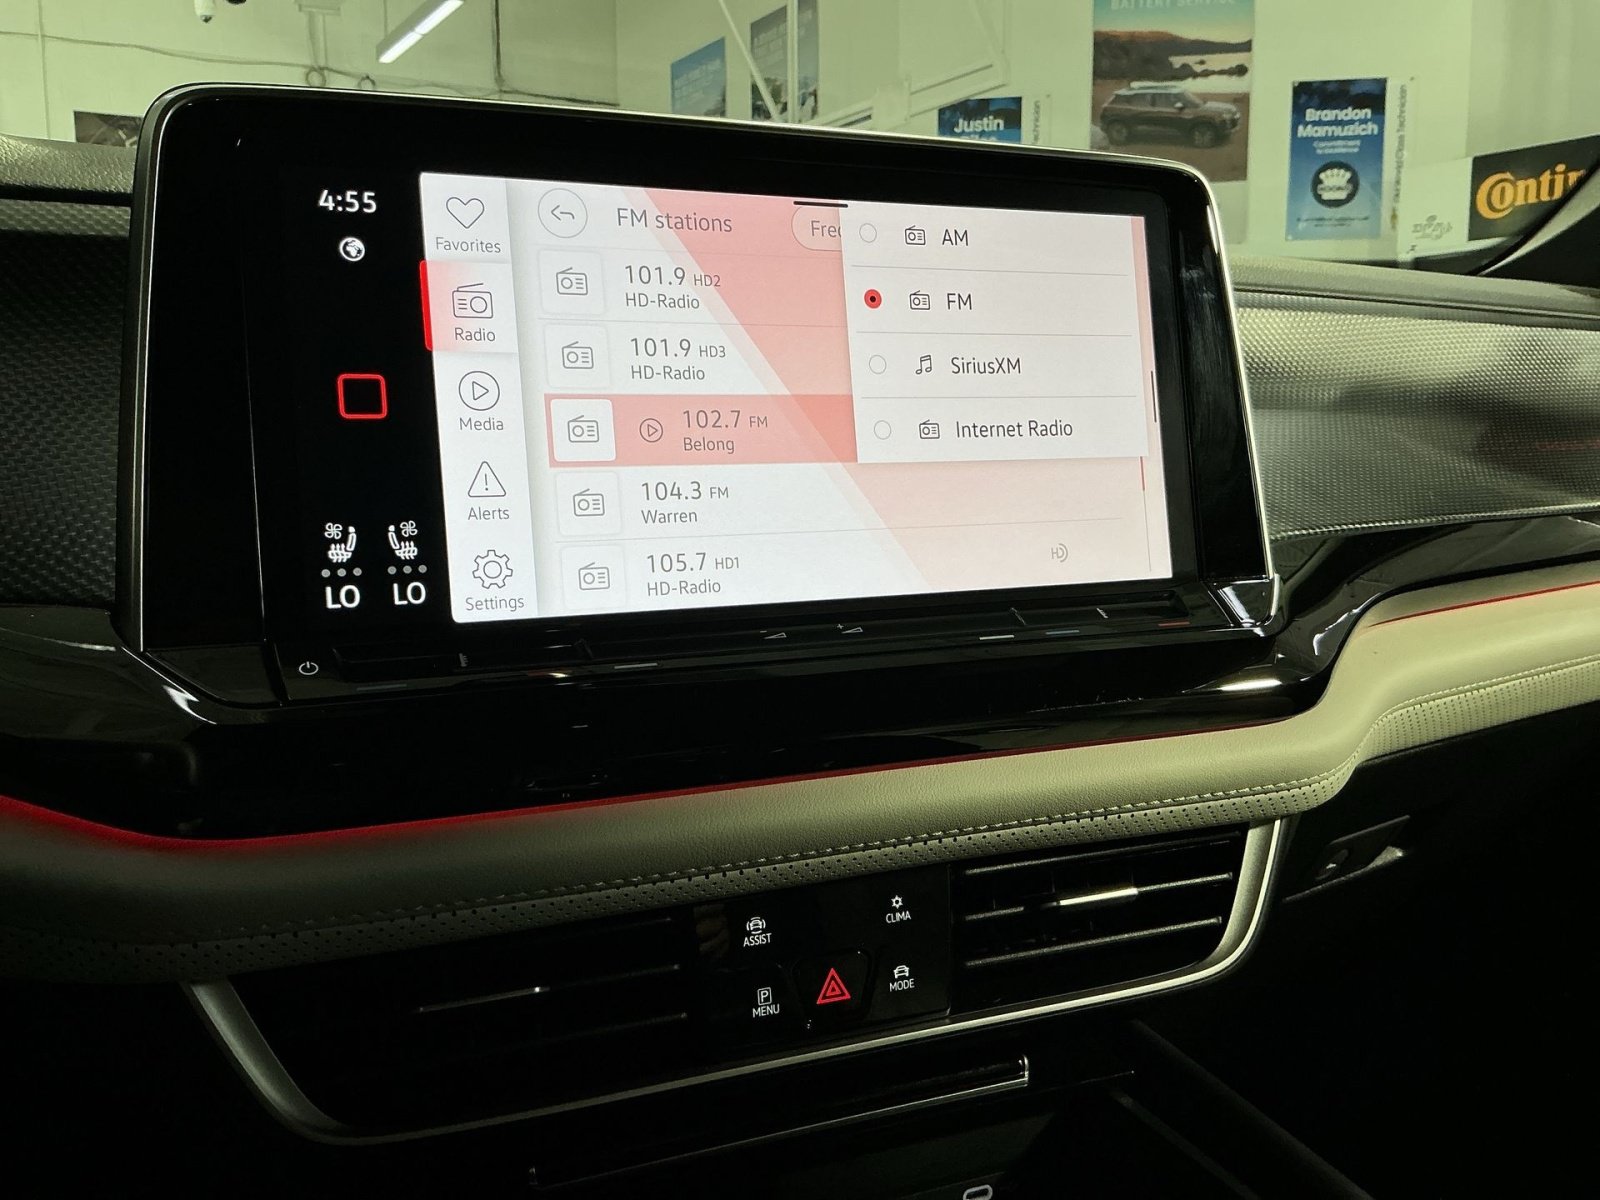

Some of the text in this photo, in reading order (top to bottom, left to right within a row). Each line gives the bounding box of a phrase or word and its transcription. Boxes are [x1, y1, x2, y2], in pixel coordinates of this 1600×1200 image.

[1305, 107, 1372, 121] Brandon
[953, 115, 1005, 133] Justin
[1297, 121, 1379, 138] Mamuzich
[318, 189, 378, 213] 4:55
[617, 207, 733, 232] FM stations
[435, 236, 501, 254] Favorites
[942, 228, 969, 247] AM
[625, 265, 721, 287] 101.9 HD2
[625, 292, 700, 309] HD-Radio
[946, 293, 973, 310] FM
[454, 326, 497, 343] Radio
[630, 338, 727, 358] 101.9 HD3
[630, 364, 706, 381] HD-Radio
[950, 356, 1021, 375] SiriusXM
[458, 416, 505, 432] Media
[683, 409, 769, 429] 102.7 FM
[956, 419, 1073, 439] Internet Radio
[683, 436, 735, 455] Belong
[641, 480, 729, 501] 104.3 FM
[467, 505, 510, 522] Alerts
[641, 509, 698, 524] Warren
[646, 551, 740, 573] 105.7 HD1
[393, 581, 426, 606] LO
[647, 578, 721, 597] HD-Radio
[325, 585, 361, 609] LO
[465, 594, 525, 614] Settings
[885, 910, 912, 924] CLIMA
[743, 932, 772, 948] ASSIST
[889, 978, 915, 993] MODE
[752, 1003, 780, 1018] MENU
